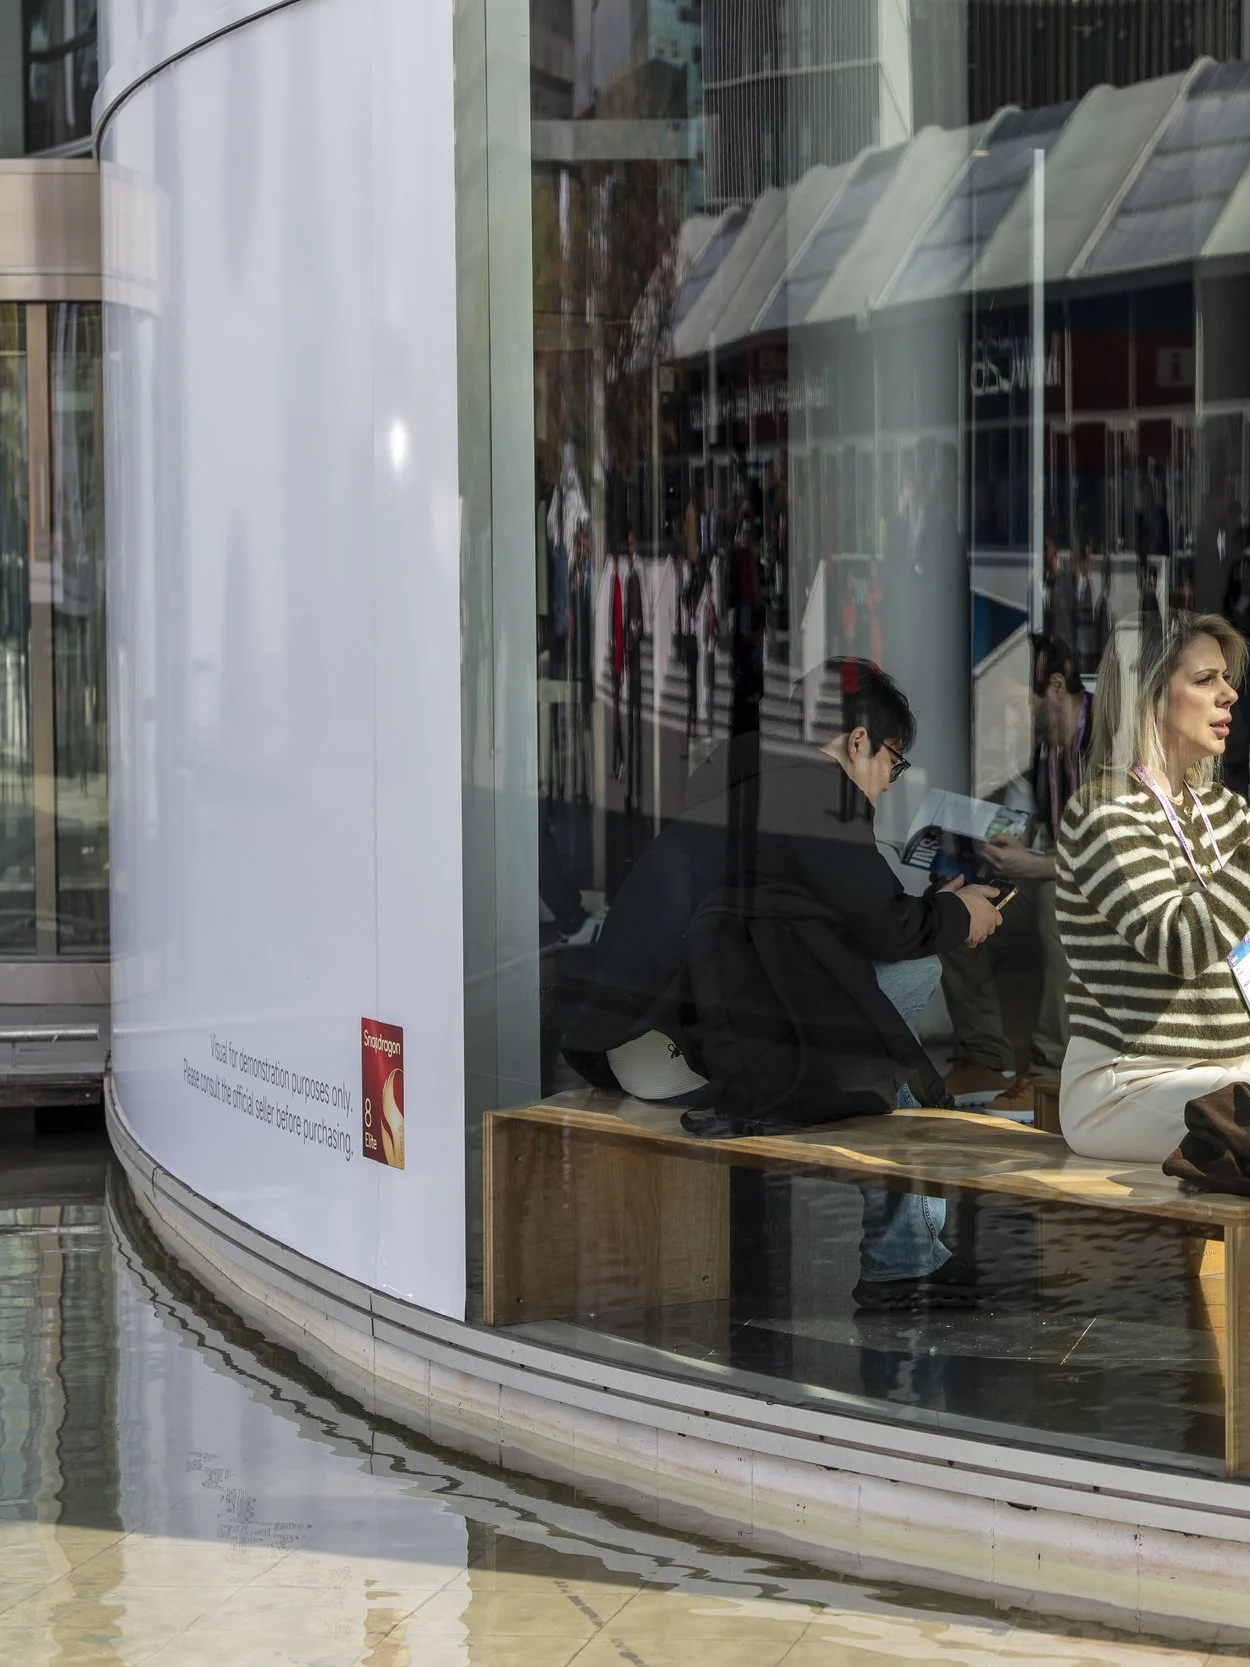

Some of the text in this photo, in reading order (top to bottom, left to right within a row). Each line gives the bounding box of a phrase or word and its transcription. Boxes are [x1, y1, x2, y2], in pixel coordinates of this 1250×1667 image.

[363, 1030, 401, 1058] Snapdragon
[210, 1034, 354, 1118] Visual for demonstration purposes only.
[183, 1057, 354, 1162] Please consult the official seller before purchasing.
[364, 1097, 372, 1128] 8
[365, 1131, 378, 1151] Elite
